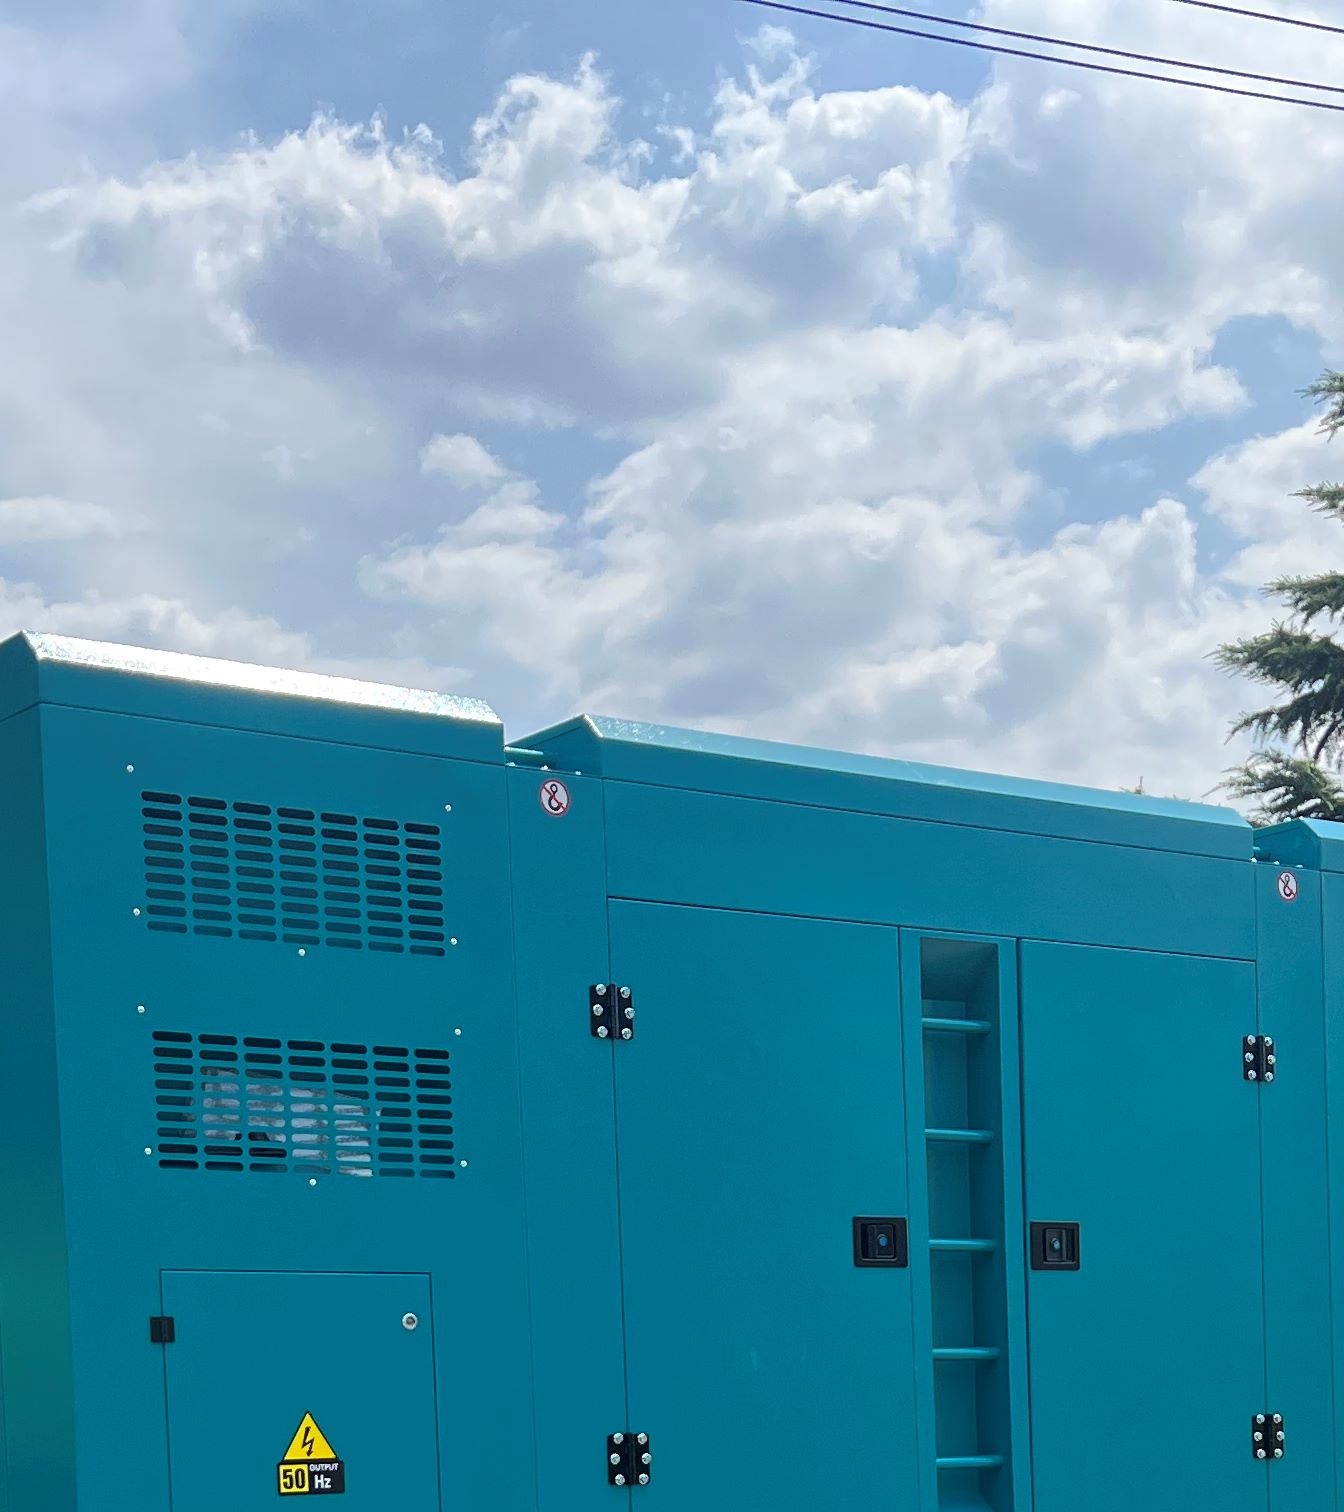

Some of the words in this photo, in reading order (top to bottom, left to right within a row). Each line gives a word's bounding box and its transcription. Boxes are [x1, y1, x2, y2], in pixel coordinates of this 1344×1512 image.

[309, 1463, 339, 1471] OUTPUT
[282, 1468, 306, 1489] 50
[314, 1474, 332, 1489] Hz
